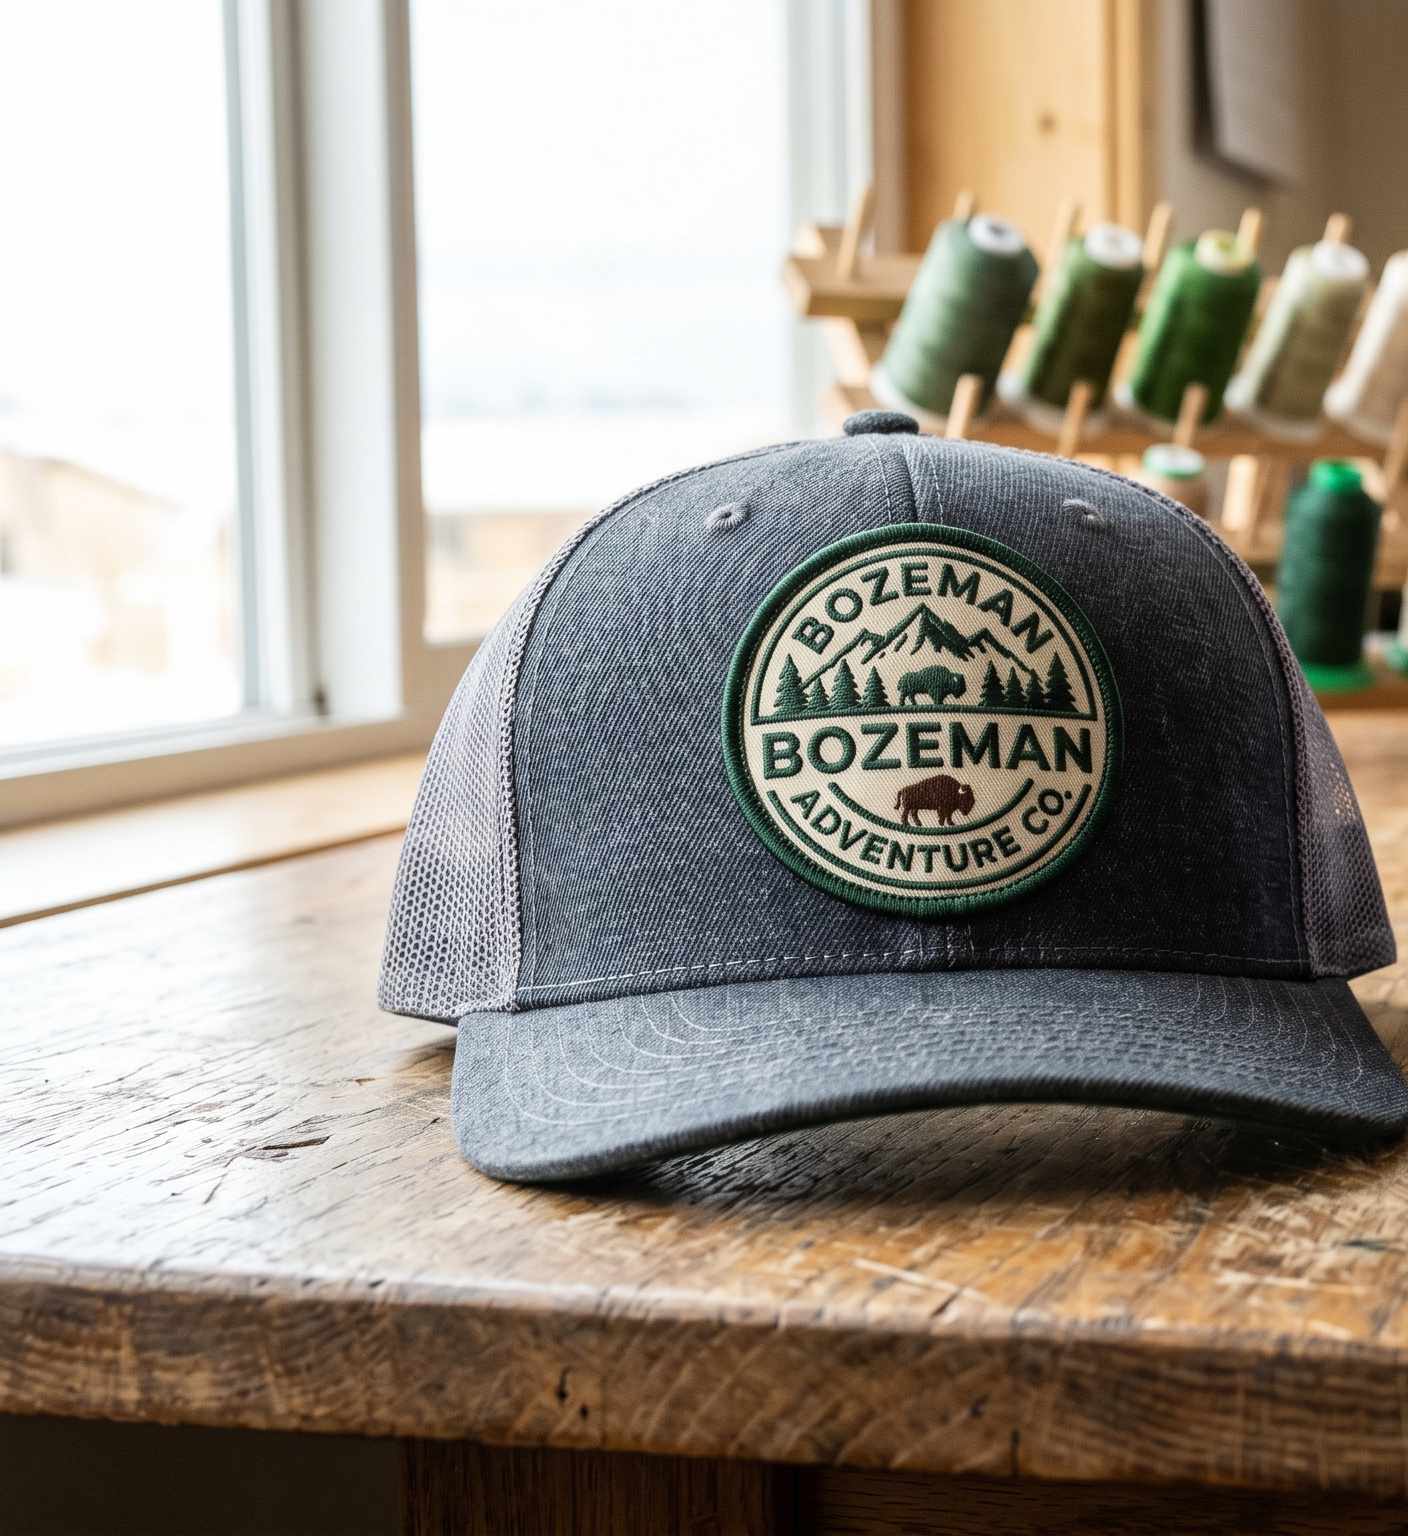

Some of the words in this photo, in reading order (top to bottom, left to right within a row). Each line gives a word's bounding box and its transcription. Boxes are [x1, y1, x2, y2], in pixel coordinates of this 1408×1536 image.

[792, 562, 1053, 654] BOZEMAN
[762, 722, 1092, 780] BOZEMAN
[791, 789, 1020, 873] ADVENTURE
[1022, 791, 1072, 835] CO.
